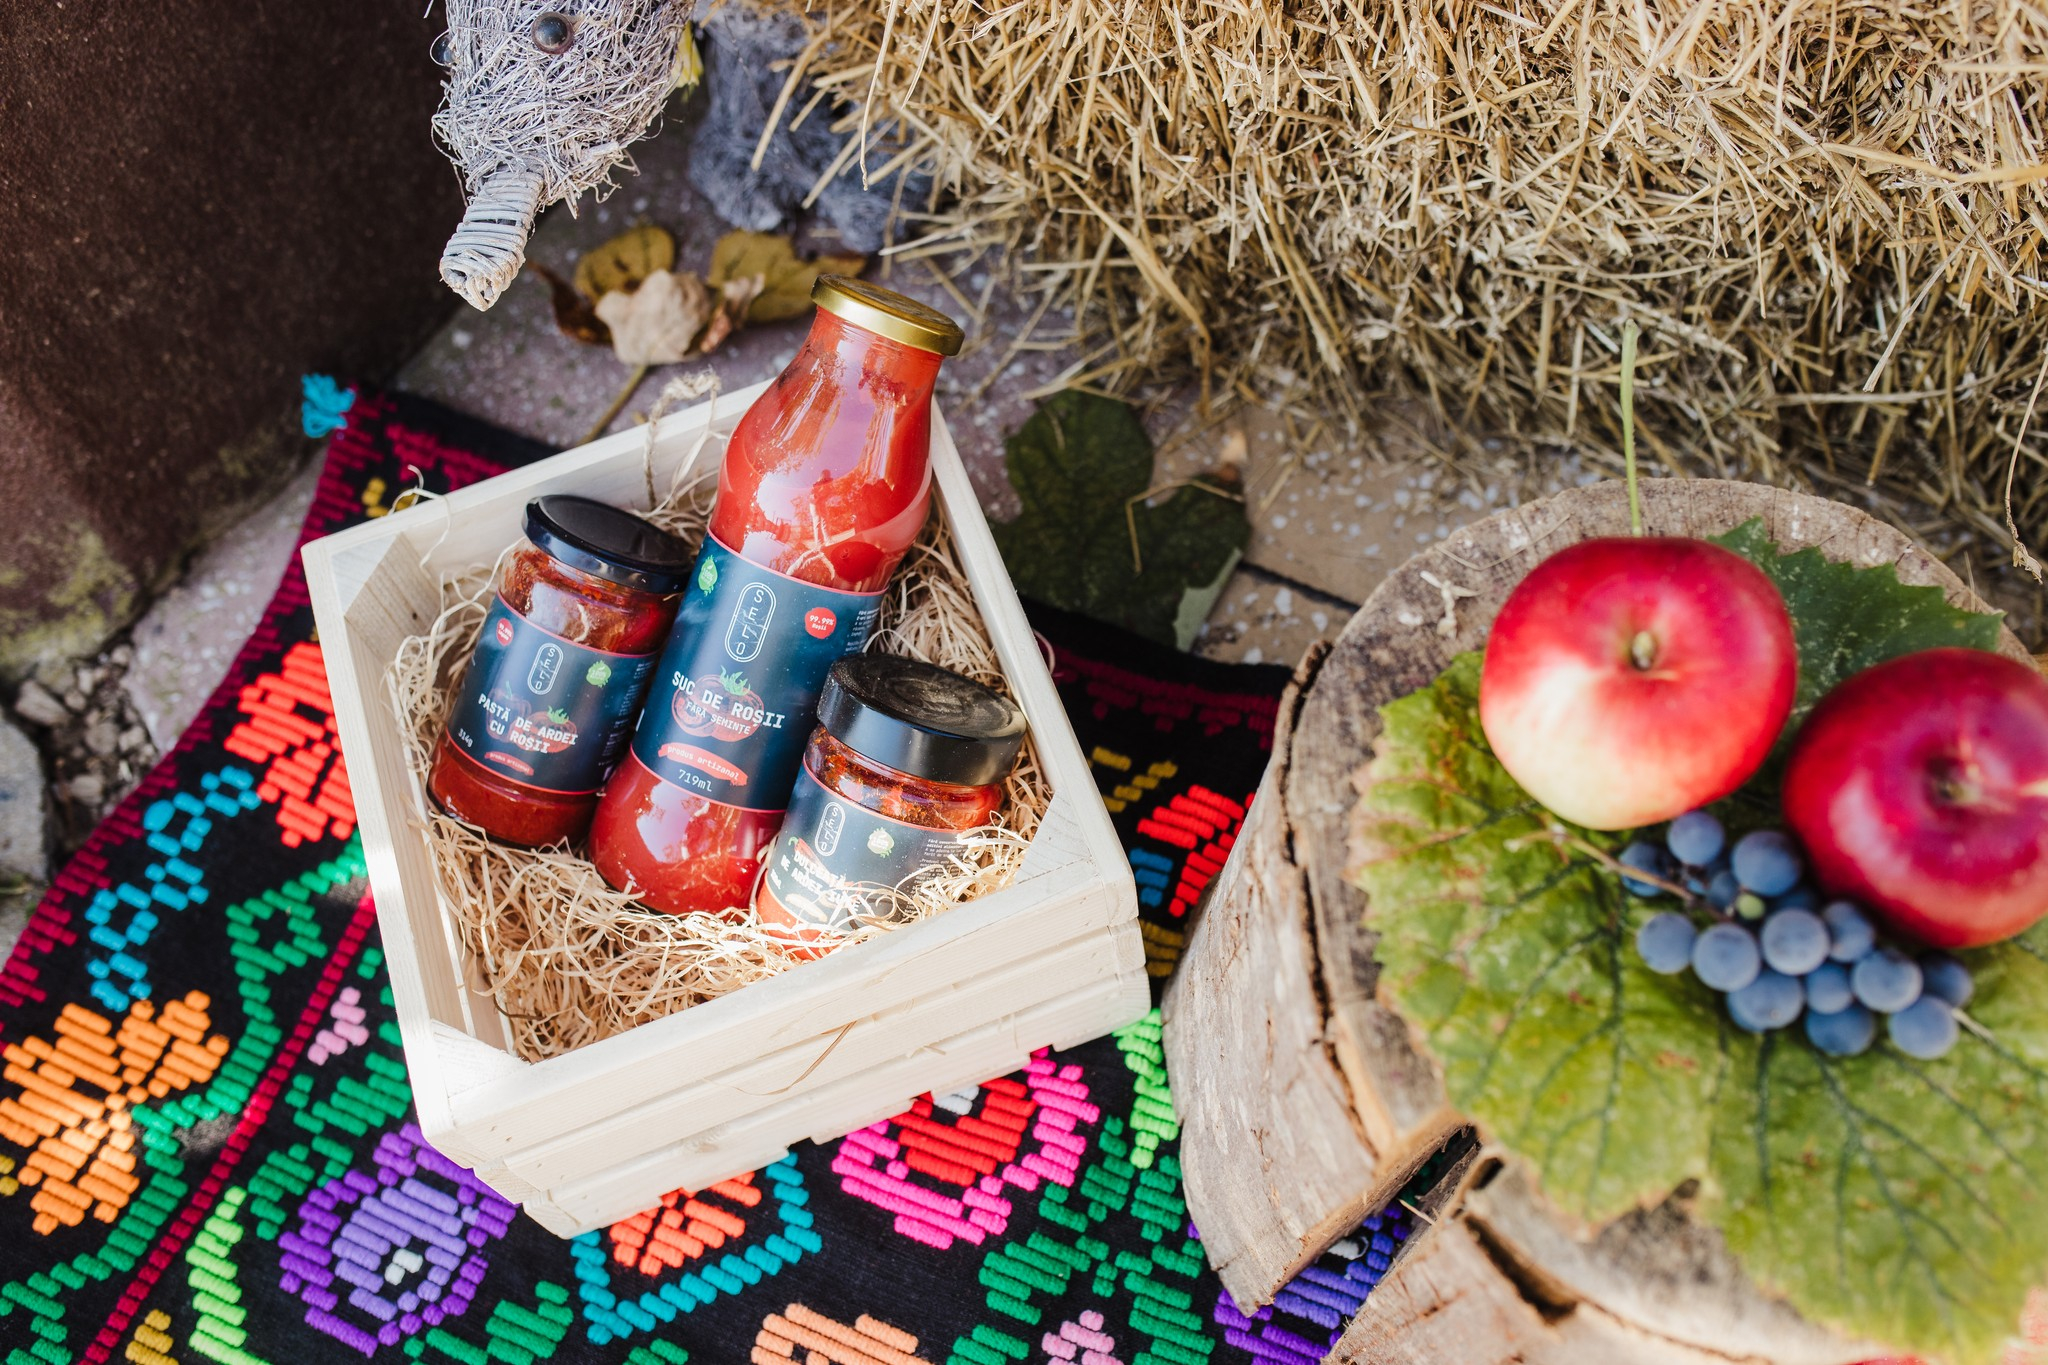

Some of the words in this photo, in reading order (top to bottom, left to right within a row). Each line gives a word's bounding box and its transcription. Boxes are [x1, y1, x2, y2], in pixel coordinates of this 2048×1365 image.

[736, 589, 764, 655] SELO
[809, 615, 834, 626] 99.99%
[535, 648, 556, 690] SELO
[478, 693, 511, 722] PASTĂ
[515, 716, 533, 732] DE
[537, 728, 578, 746] ARDEI
[672, 671, 695, 695] SUC
[702, 689, 723, 710] DE
[731, 702, 785, 728] ROȘII
[489, 720, 505, 735] CU
[509, 731, 550, 754] ROȘII
[667, 745, 694, 760] produs
[697, 756, 740, 780] artizanal
[678, 768, 712, 792] 719ml
[820, 807, 839, 851] SELO
